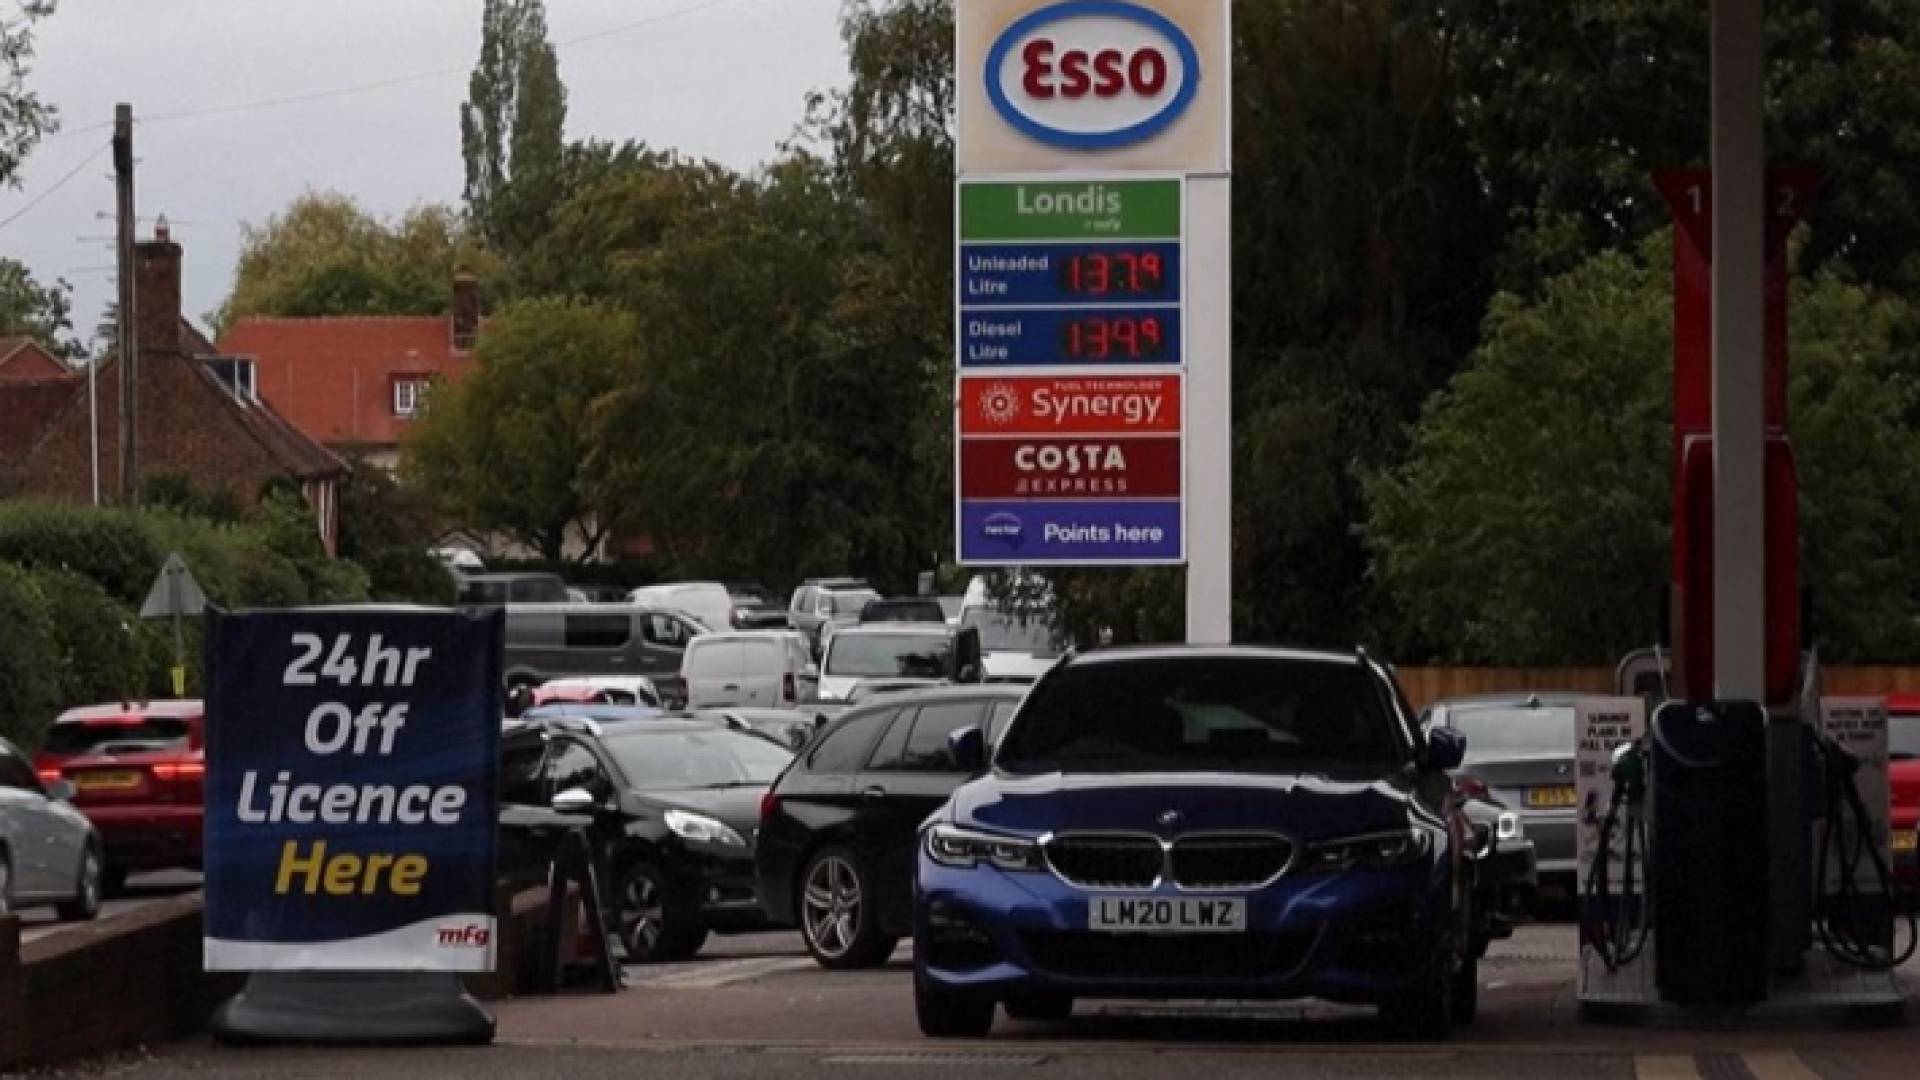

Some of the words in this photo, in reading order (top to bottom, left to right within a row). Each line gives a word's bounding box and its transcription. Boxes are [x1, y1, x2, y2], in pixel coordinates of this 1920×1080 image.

[1022, 38, 1167, 98] Esso
[1017, 186, 1121, 214] Londis
[1687, 183, 1700, 215] 1
[1776, 186, 1795, 216] 2
[968, 255, 1049, 271] Unleaded
[968, 278, 1008, 295] Litre
[968, 320, 1022, 336] Diesel
[968, 344, 1008, 360] Litre
[1031, 388, 1162, 424] Synergy
[1014, 445, 1127, 474] COSTA
[1031, 478, 1128, 492] EXPRESS
[1044, 522, 1110, 543] Points
[1115, 522, 1163, 543] here
[283, 632, 433, 687] 24hr
[304, 701, 410, 756] Off
[237, 770, 468, 824] Licence
[274, 840, 429, 895] Here
[1179, 900, 1234, 926] LWZ
